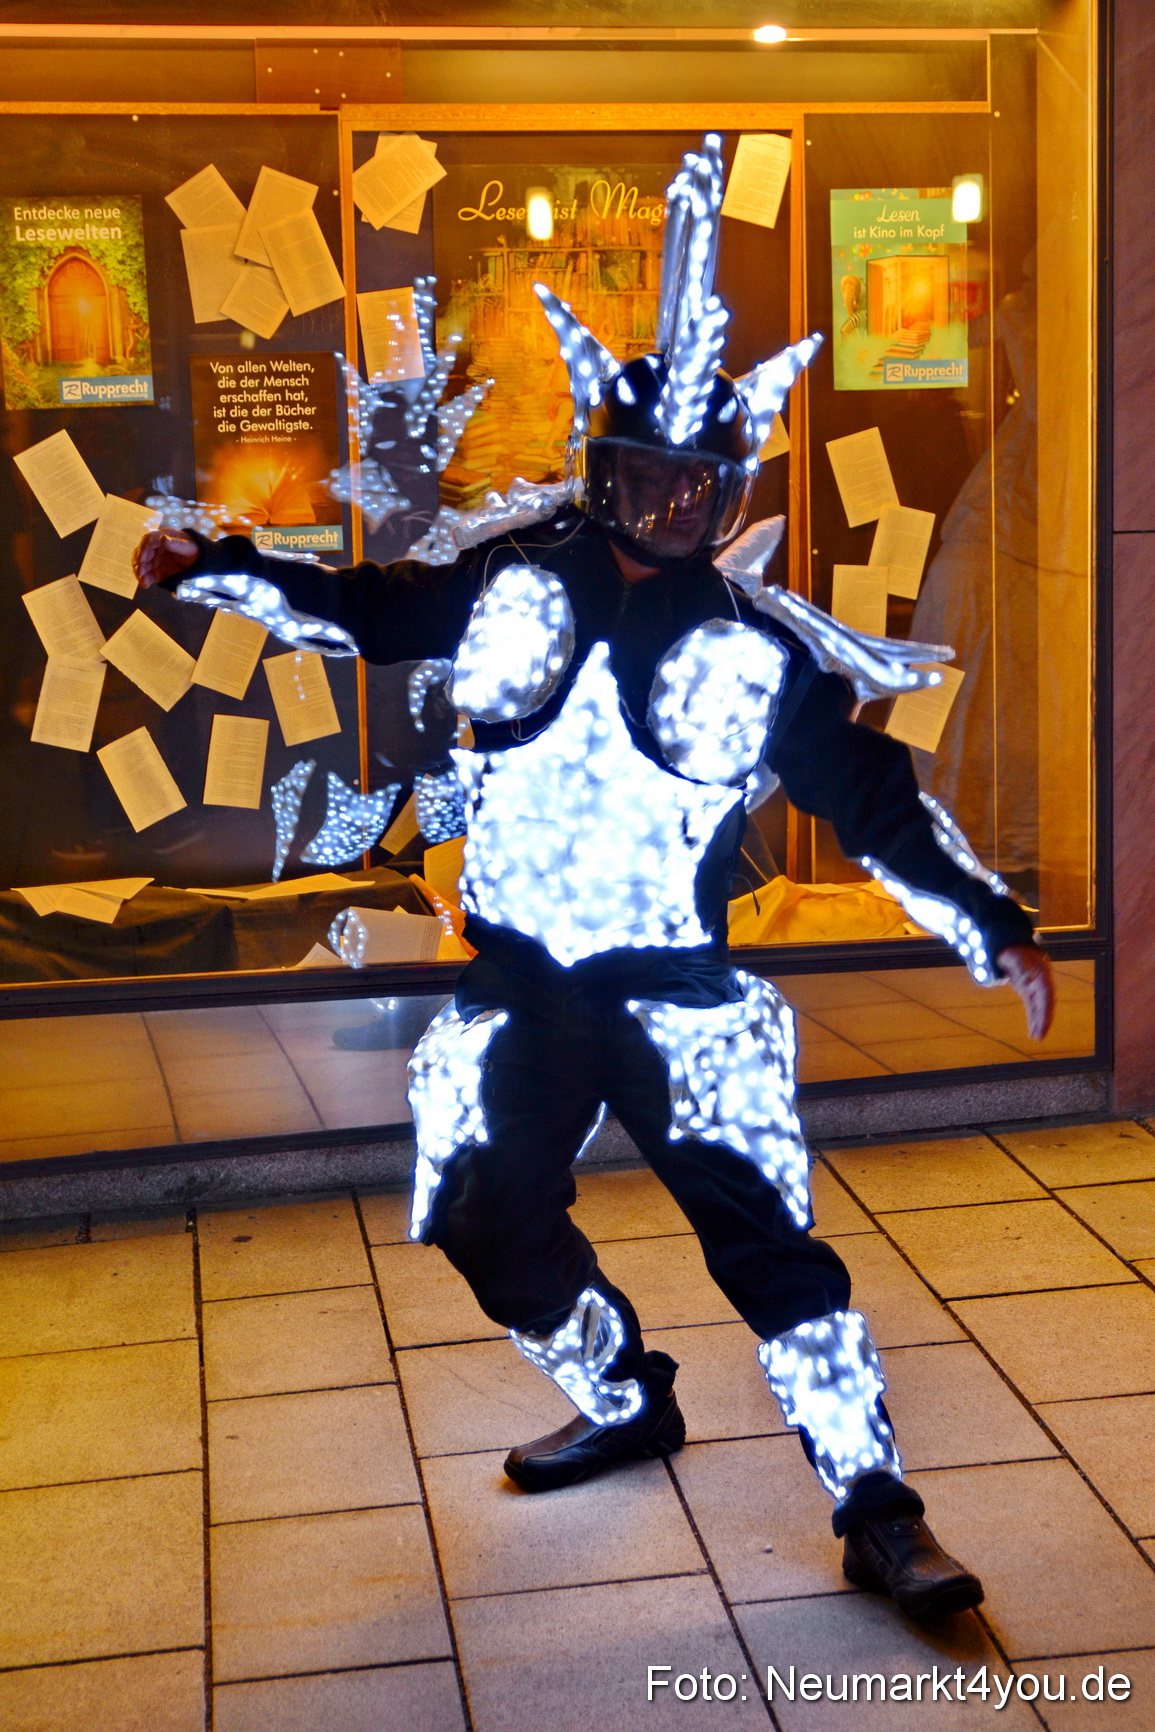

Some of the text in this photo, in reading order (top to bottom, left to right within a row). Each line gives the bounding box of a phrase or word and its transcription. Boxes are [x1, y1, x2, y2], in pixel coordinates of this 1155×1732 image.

[458, 180, 528, 221] Lese
[553, 199, 578, 220] ist
[14, 206, 121, 220] Entdecke neue
[877, 204, 920, 222] Lesen
[15, 223, 122, 242] Lesewelten
[853, 224, 945, 240] ist Kino im Kopf
[209, 359, 315, 374] Von allen Welten,
[904, 362, 963, 381] Rupprecht
[217, 374, 309, 388] die der Mensch
[82, 379, 148, 399] Rupprecht
[219, 388, 308, 403] erschaffen hat,
[213, 403, 317, 418] ist die der Bücher
[217, 418, 313, 433] die Gewaltigste.
[241, 435, 270, 443] Heinrich
[271, 434, 292, 442] Heine
[273, 529, 338, 549] Rupprecht
